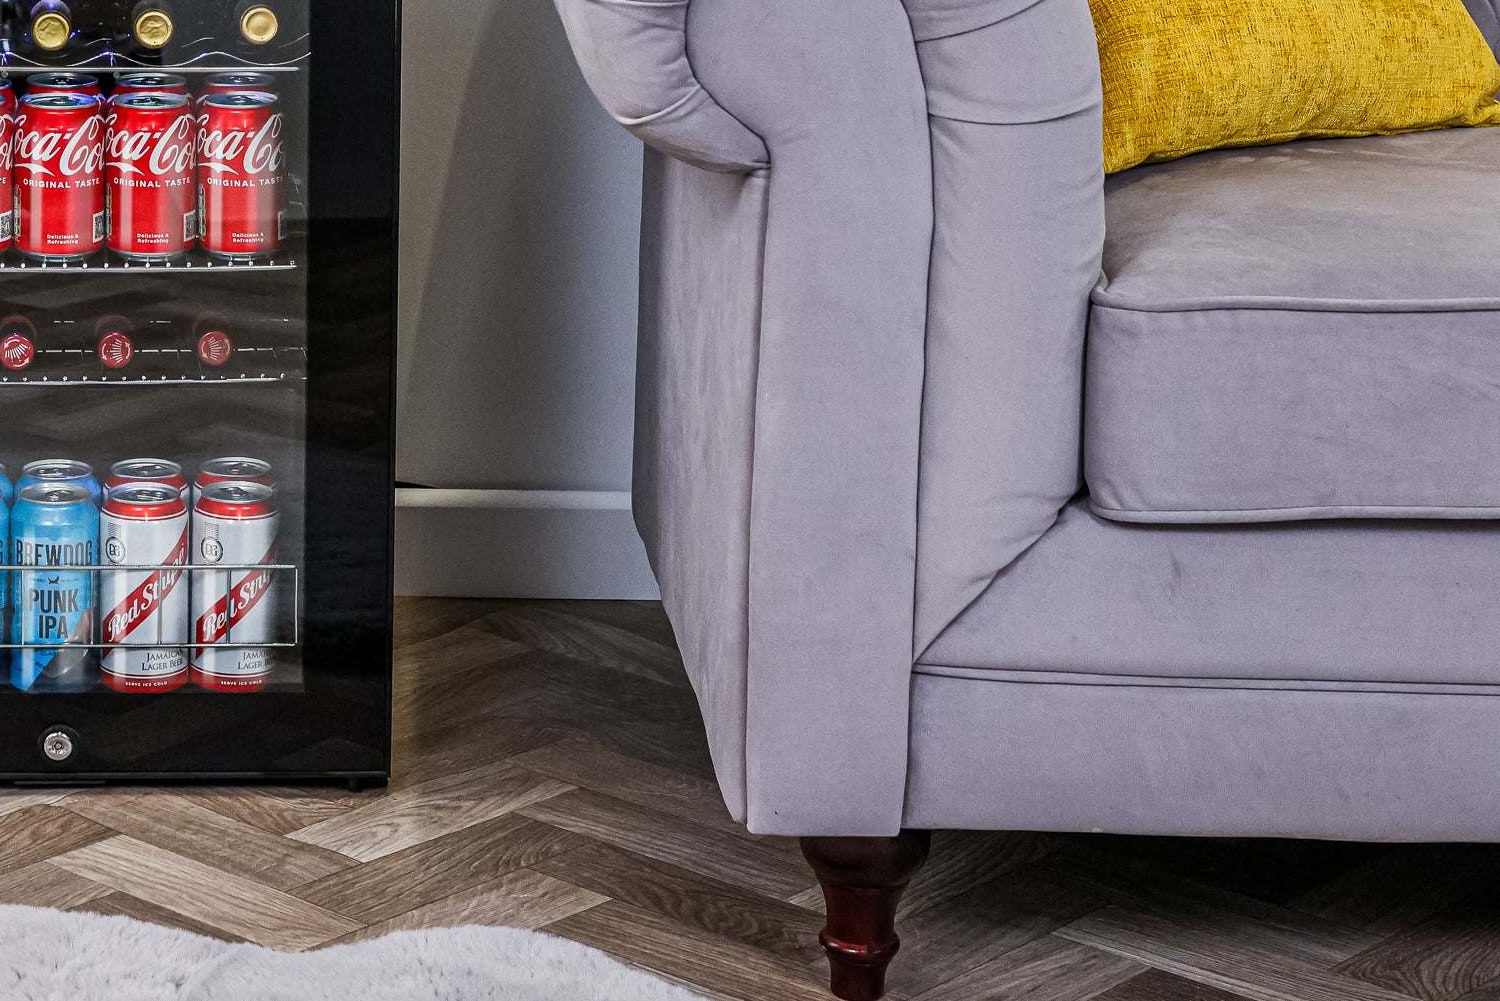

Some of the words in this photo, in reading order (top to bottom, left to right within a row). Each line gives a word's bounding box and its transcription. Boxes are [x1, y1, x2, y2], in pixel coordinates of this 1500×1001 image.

[23, 178, 71, 189] ORIGINAL
[74, 177, 100, 188] TASTE
[113, 176, 161, 188] ORIGINAL
[164, 176, 191, 187] TASTE
[207, 177, 256, 187] ORIGINAL
[16, 538, 93, 566] BREWDOG
[28, 587, 80, 614] PUNK
[108, 598, 141, 642] Red
[38, 614, 69, 639] IPA
[142, 662, 168, 671] LAGER
[237, 661, 263, 670] LAGER
